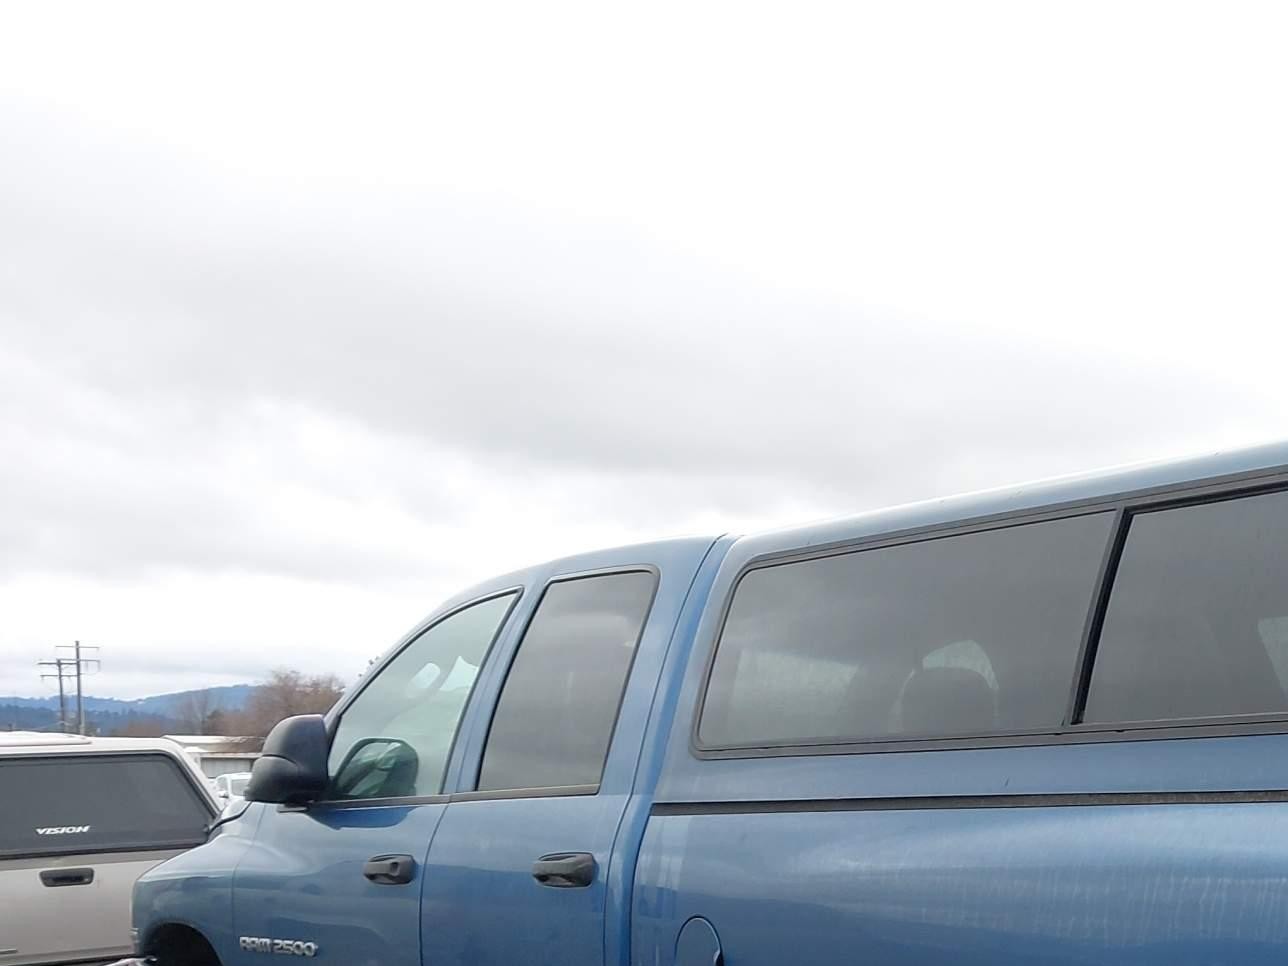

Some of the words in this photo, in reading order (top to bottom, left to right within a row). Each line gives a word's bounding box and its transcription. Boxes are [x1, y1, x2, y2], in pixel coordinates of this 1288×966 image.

[35, 825, 91, 835] VISION
[239, 936, 272, 953] RAM
[273, 938, 318, 957] 2500
